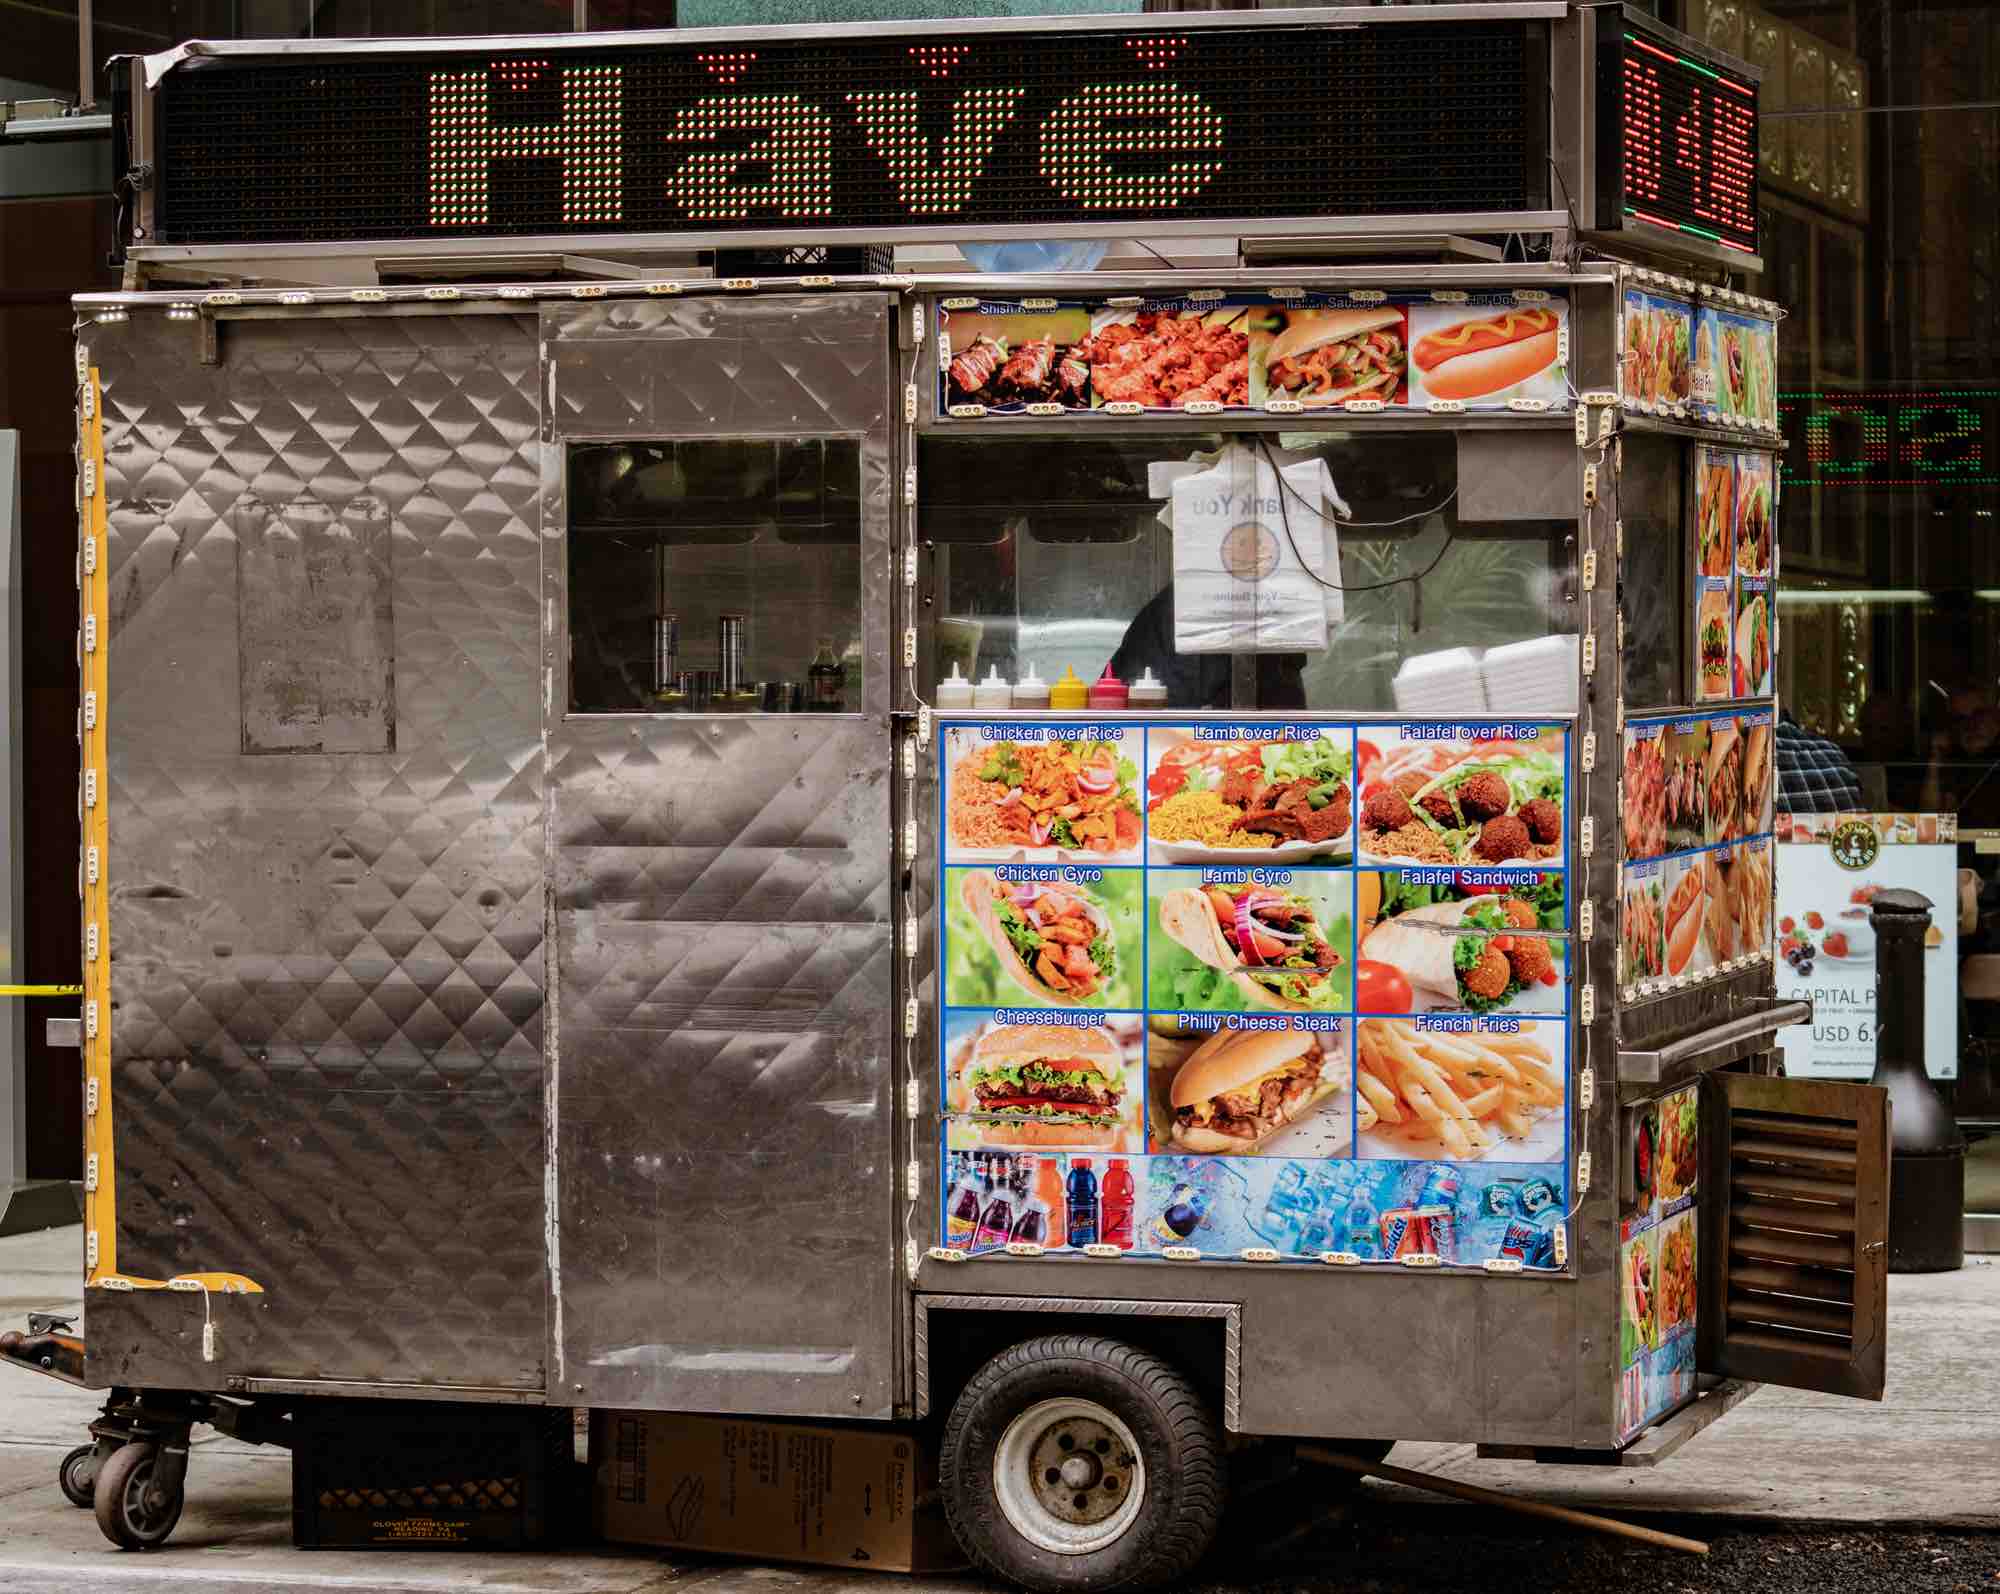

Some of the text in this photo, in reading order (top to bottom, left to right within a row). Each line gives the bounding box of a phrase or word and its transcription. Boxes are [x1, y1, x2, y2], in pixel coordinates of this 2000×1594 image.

[429, 67, 1223, 224] Have
[981, 725, 1124, 741] Chicken over Rice
[1194, 724, 1321, 740] Lamb over Rice
[1400, 724, 1538, 740] Falafel over Rice
[996, 865, 1103, 886] Chicken Gyro
[1202, 867, 1292, 887] Lamb Gyro
[1400, 869, 1539, 885] Falafel Sandwich
[994, 1009, 1106, 1030] Cheeseburger
[1178, 1013, 1341, 1032] Philly Cheese Steak
[1416, 1015, 1520, 1033] French Fries
[1812, 1024, 1850, 1042] USD
